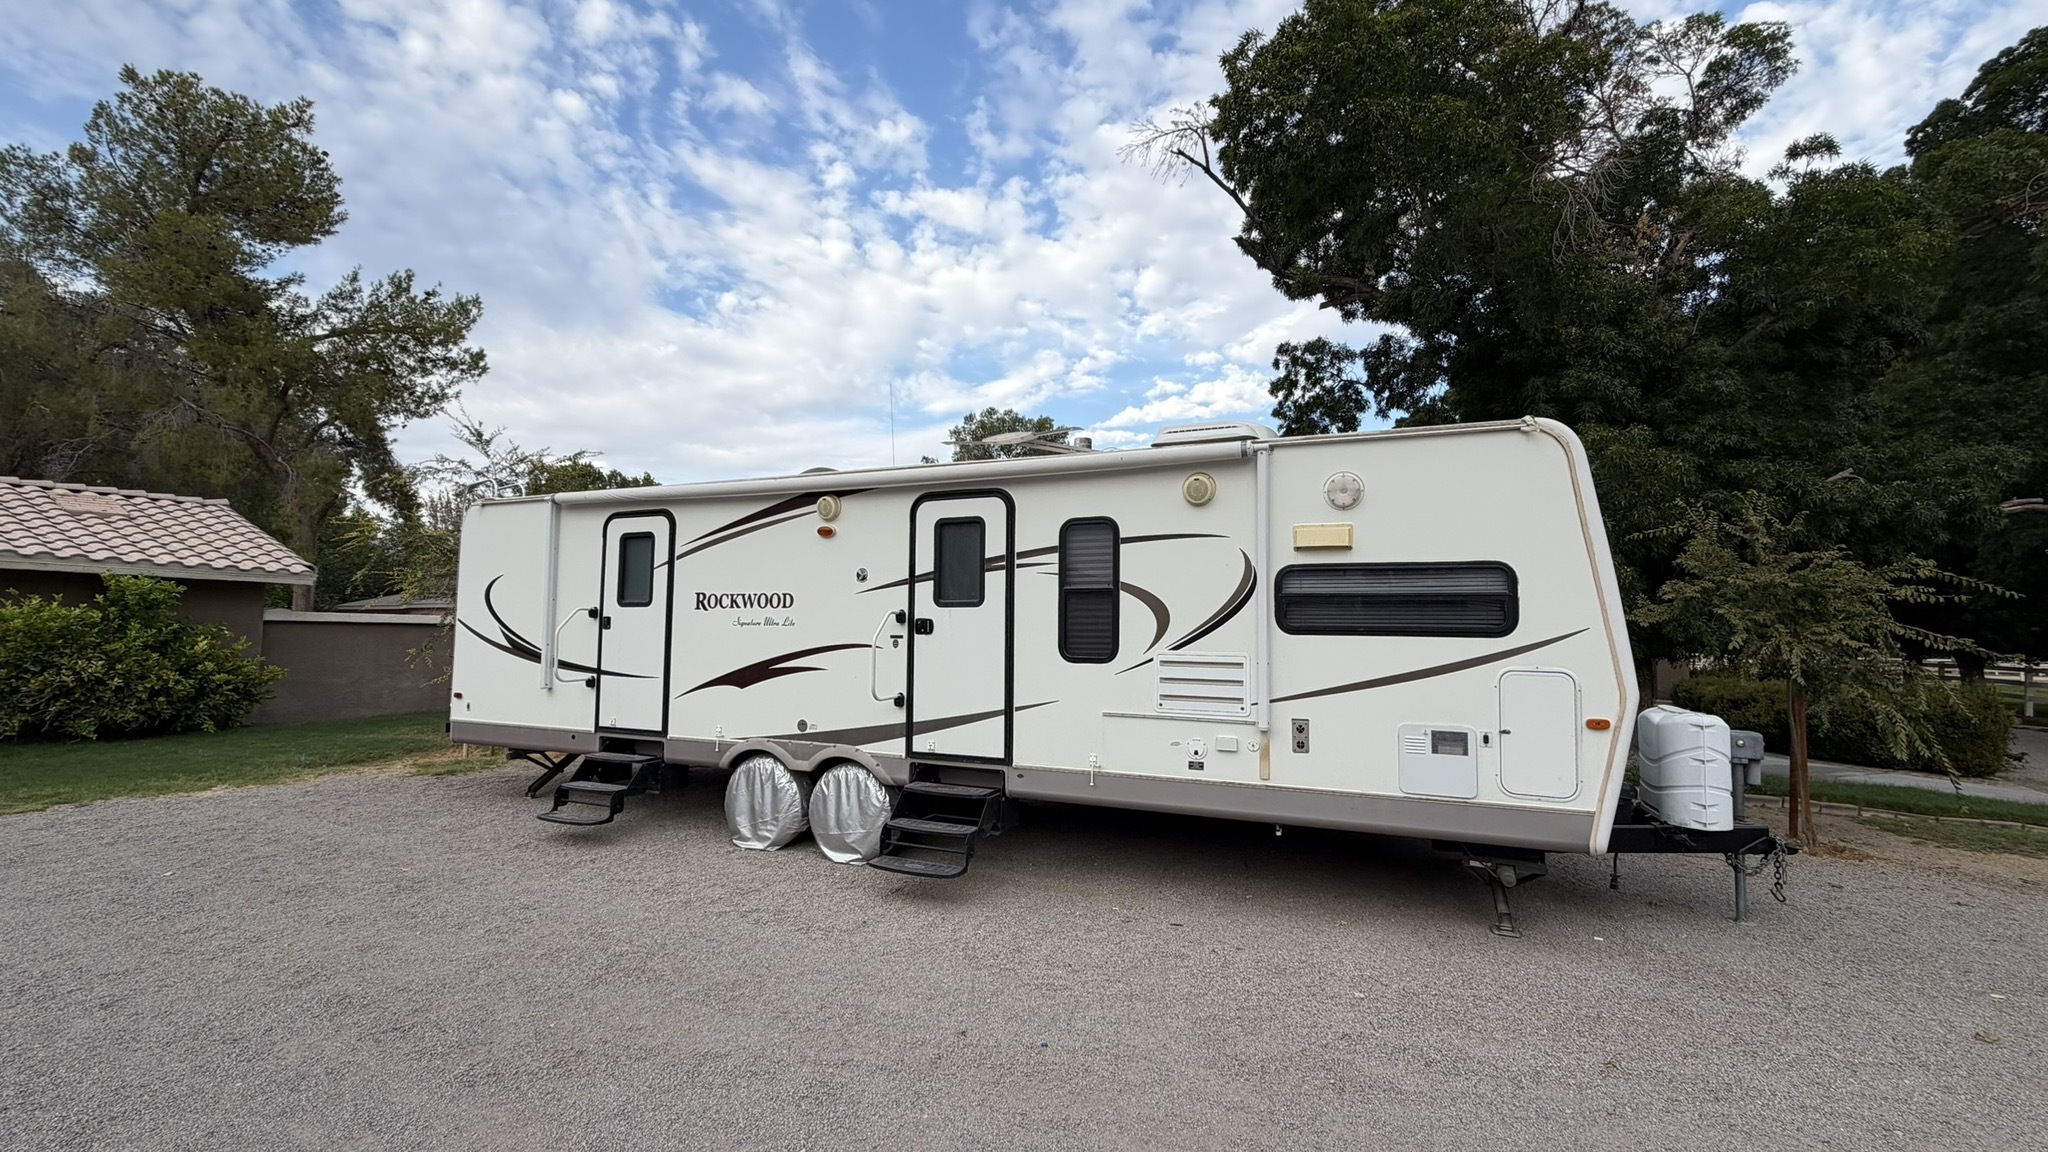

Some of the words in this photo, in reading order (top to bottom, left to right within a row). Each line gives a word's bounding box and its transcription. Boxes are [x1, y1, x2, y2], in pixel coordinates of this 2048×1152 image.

[694, 592, 794, 611] ROCKWOOD
[732, 616, 762, 628] Signature
[763, 616, 780, 627] Ultra
[781, 616, 796, 627] Lite
